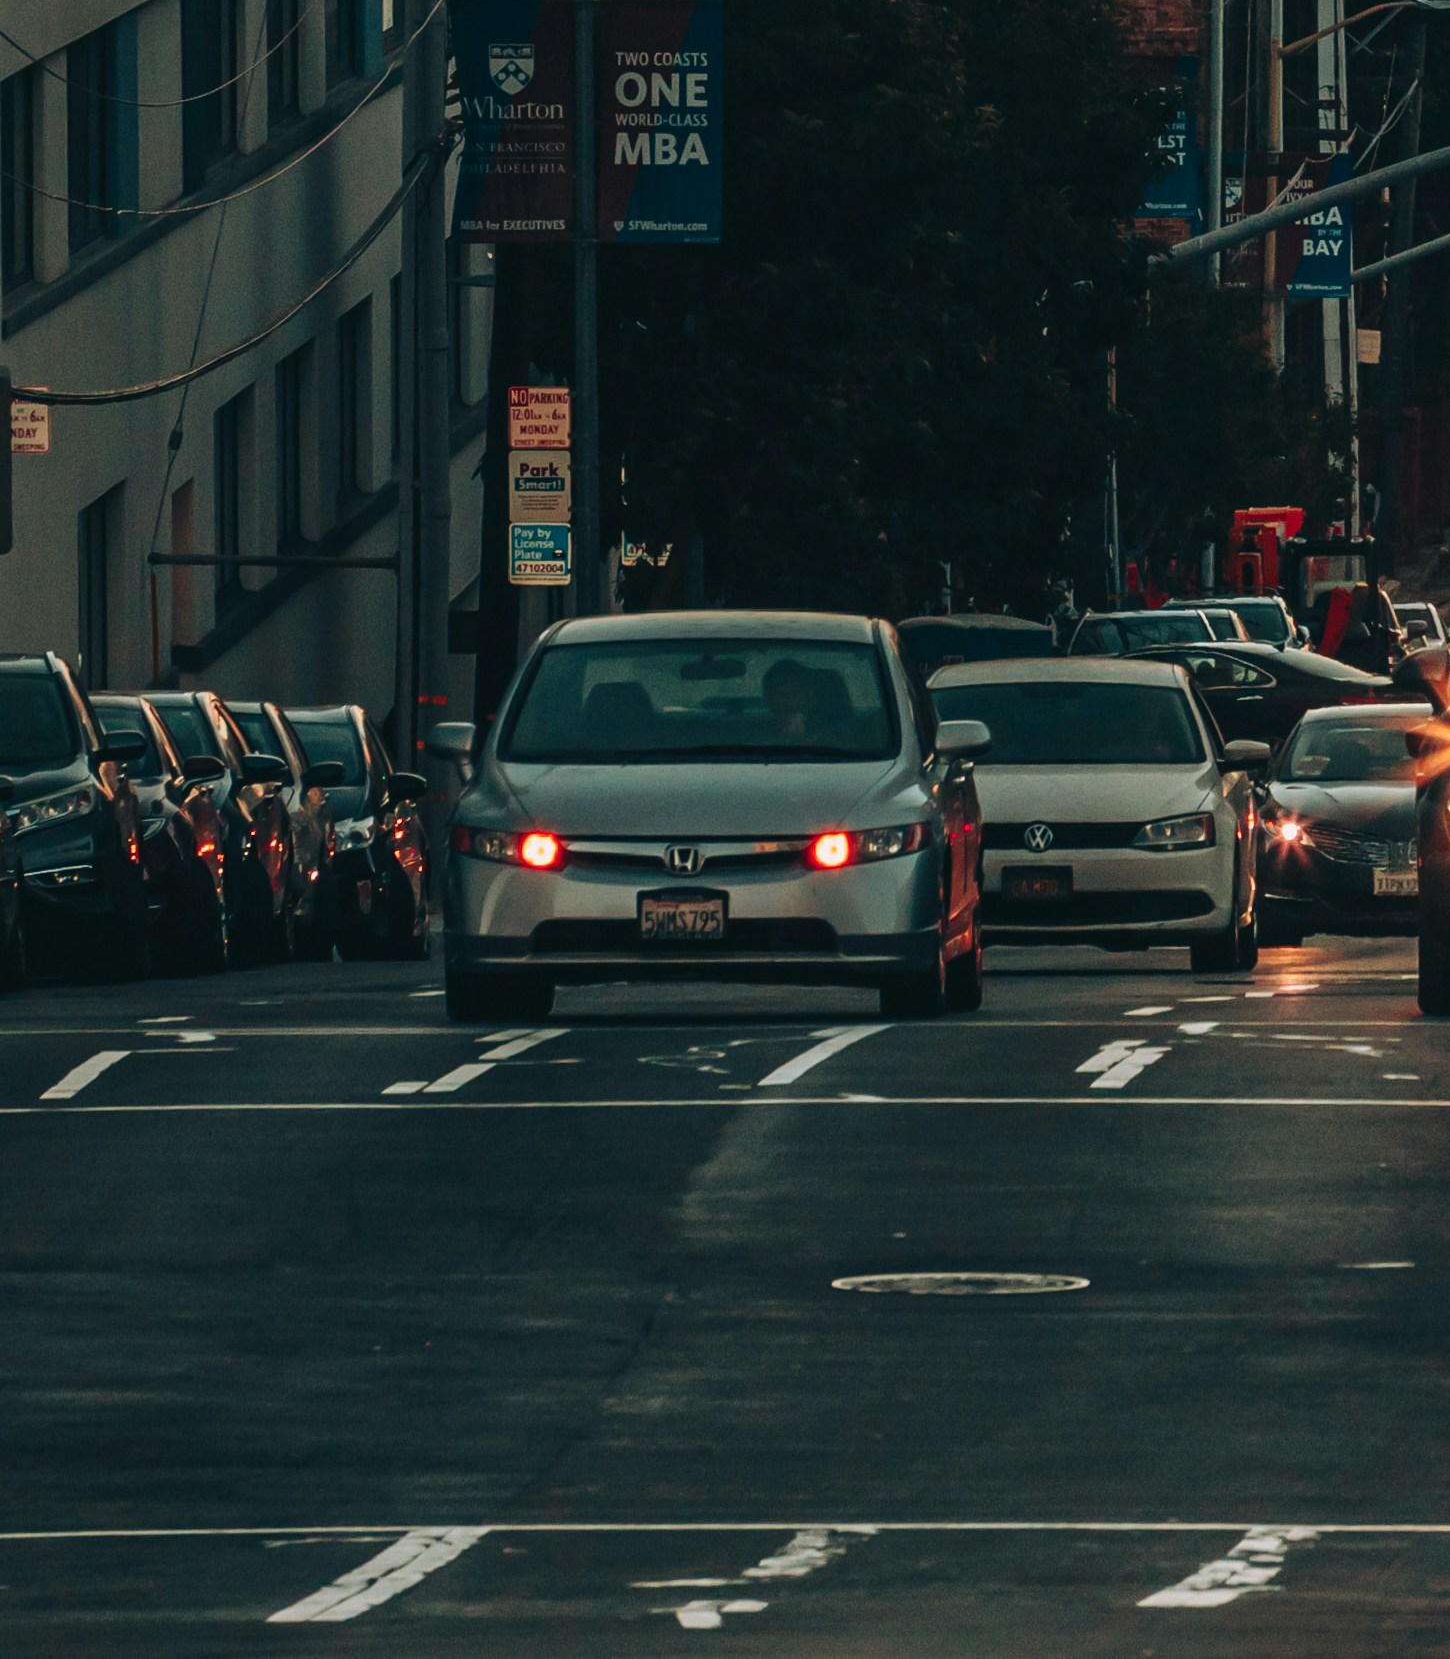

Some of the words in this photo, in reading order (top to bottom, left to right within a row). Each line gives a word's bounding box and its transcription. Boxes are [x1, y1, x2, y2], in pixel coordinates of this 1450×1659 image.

[615, 52, 649, 67] TWO
[653, 52, 708, 67] COASTS
[614, 71, 708, 108] ONE
[462, 95, 565, 120] Wharton
[615, 113, 709, 127] WORLD-CLASS
[490, 141, 566, 153] FRANCISCO
[613, 132, 710, 166] MBA
[503, 219, 566, 231] EXECUTIVES
[1303, 239, 1344, 256] BAY
[510, 389, 527, 404] NO
[530, 393, 569, 404] PARKING
[10, 427, 37, 439] NDAY
[520, 424, 559, 435] MONDAY
[519, 462, 559, 477] Park
[518, 478, 561, 490] Smart!
[514, 527, 534, 539] Pay
[537, 527, 551, 539] by
[514, 539, 555, 549] License
[514, 549, 542, 560] Plate
[515, 563, 564, 573] 47102004
